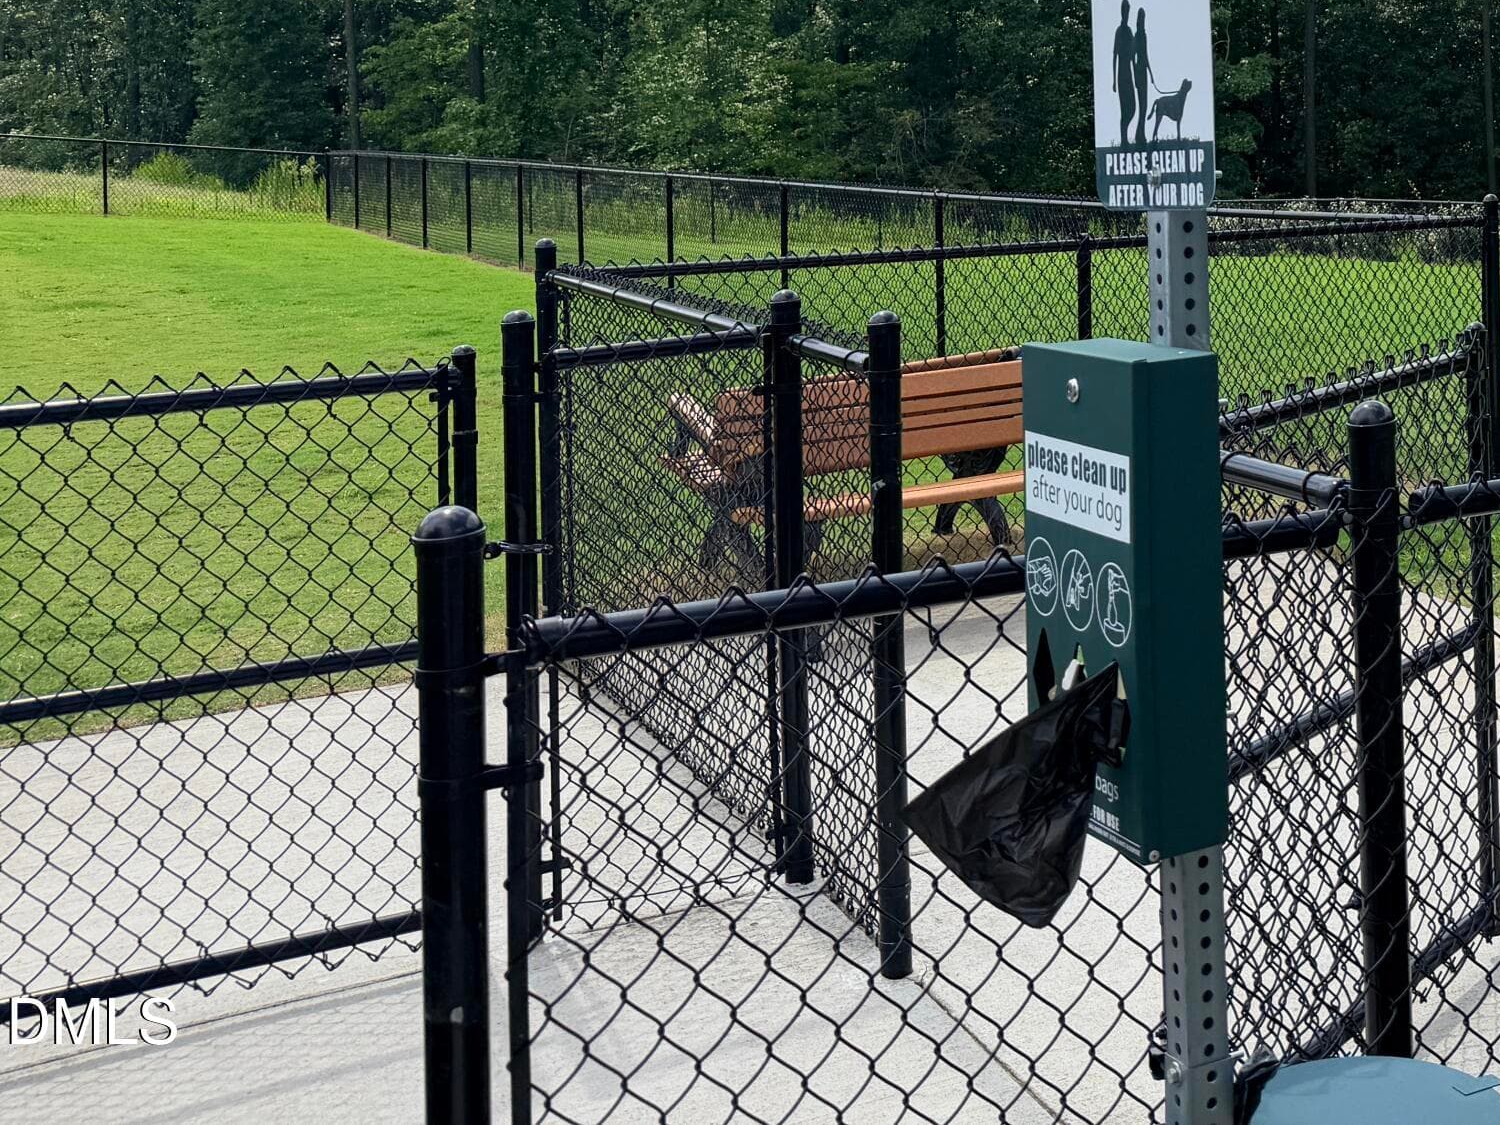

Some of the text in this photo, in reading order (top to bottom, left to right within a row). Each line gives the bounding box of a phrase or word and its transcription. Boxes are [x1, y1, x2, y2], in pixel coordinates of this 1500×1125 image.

[1106, 149, 1205, 175] PLEASE CLEAN UP
[1108, 182, 1204, 207] AFTER YOUR DOG
[1028, 440, 1127, 495] please clean up
[1032, 474, 1122, 531] after your dog
[1095, 773, 1119, 803] bags
